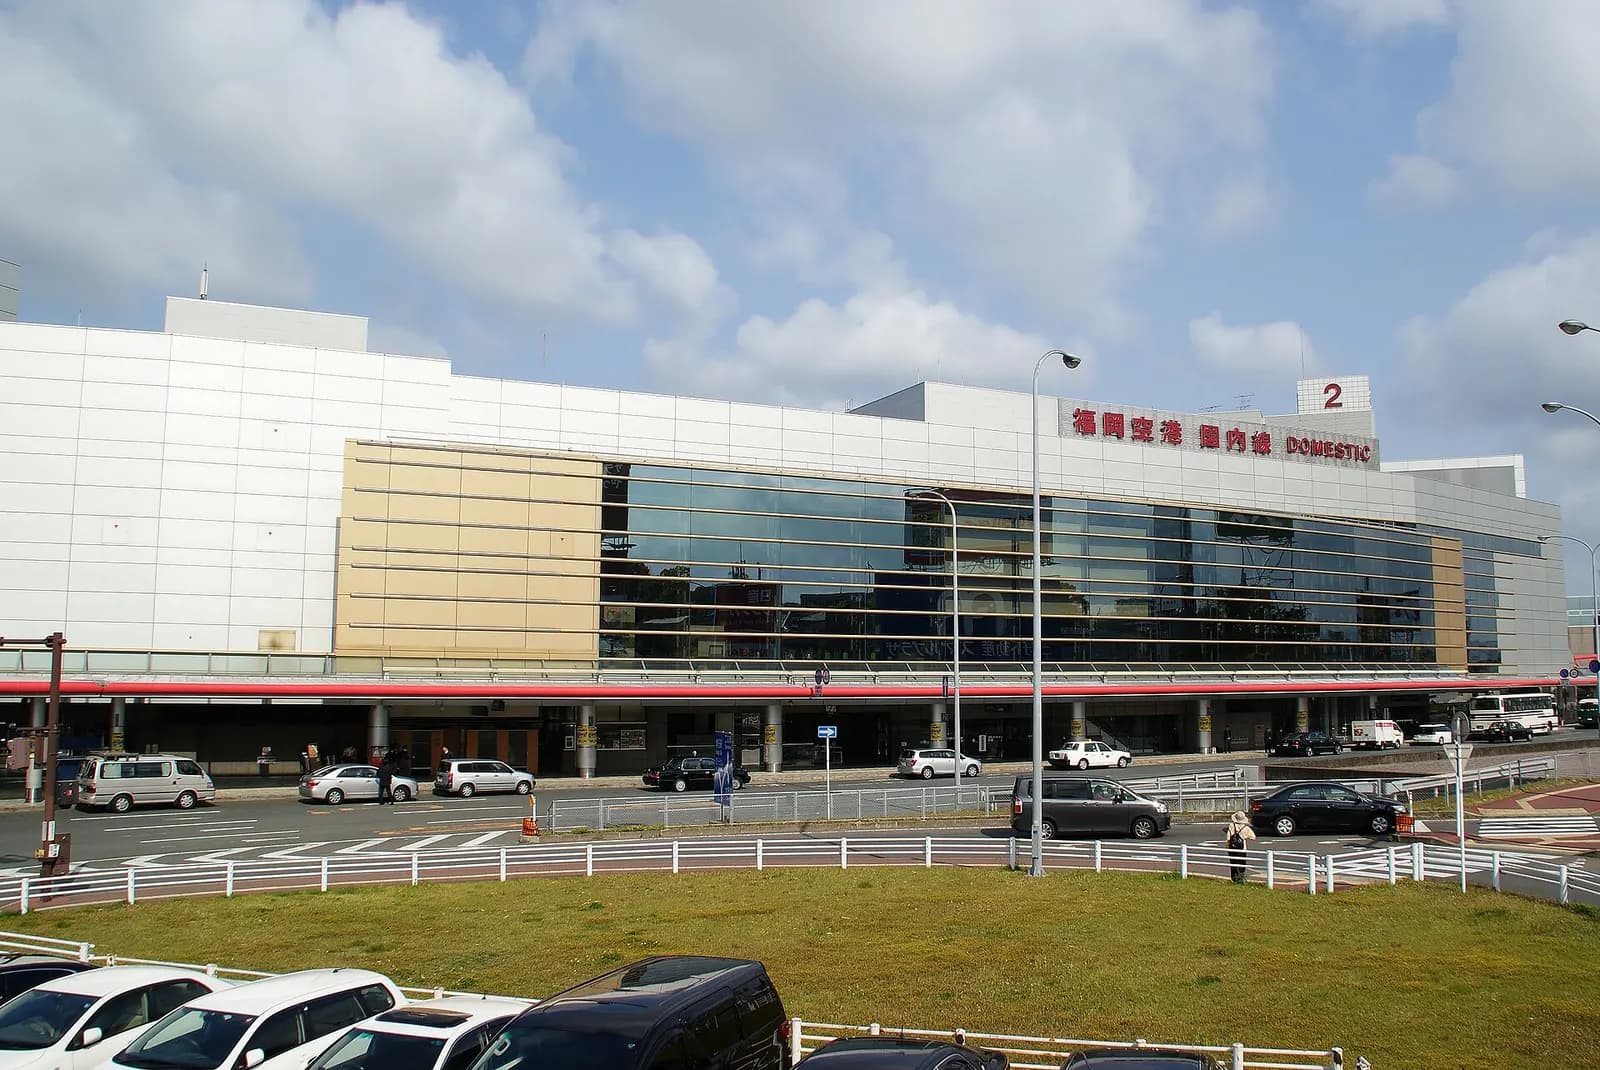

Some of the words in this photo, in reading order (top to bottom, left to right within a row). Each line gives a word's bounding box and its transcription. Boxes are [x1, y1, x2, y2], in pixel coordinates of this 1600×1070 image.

[1323, 383, 1343, 409] 2
[1073, 408, 1182, 445] 福岡空港
[1200, 424, 1272, 455] 国内線
[1286, 436, 1371, 462] DOMESTIC
